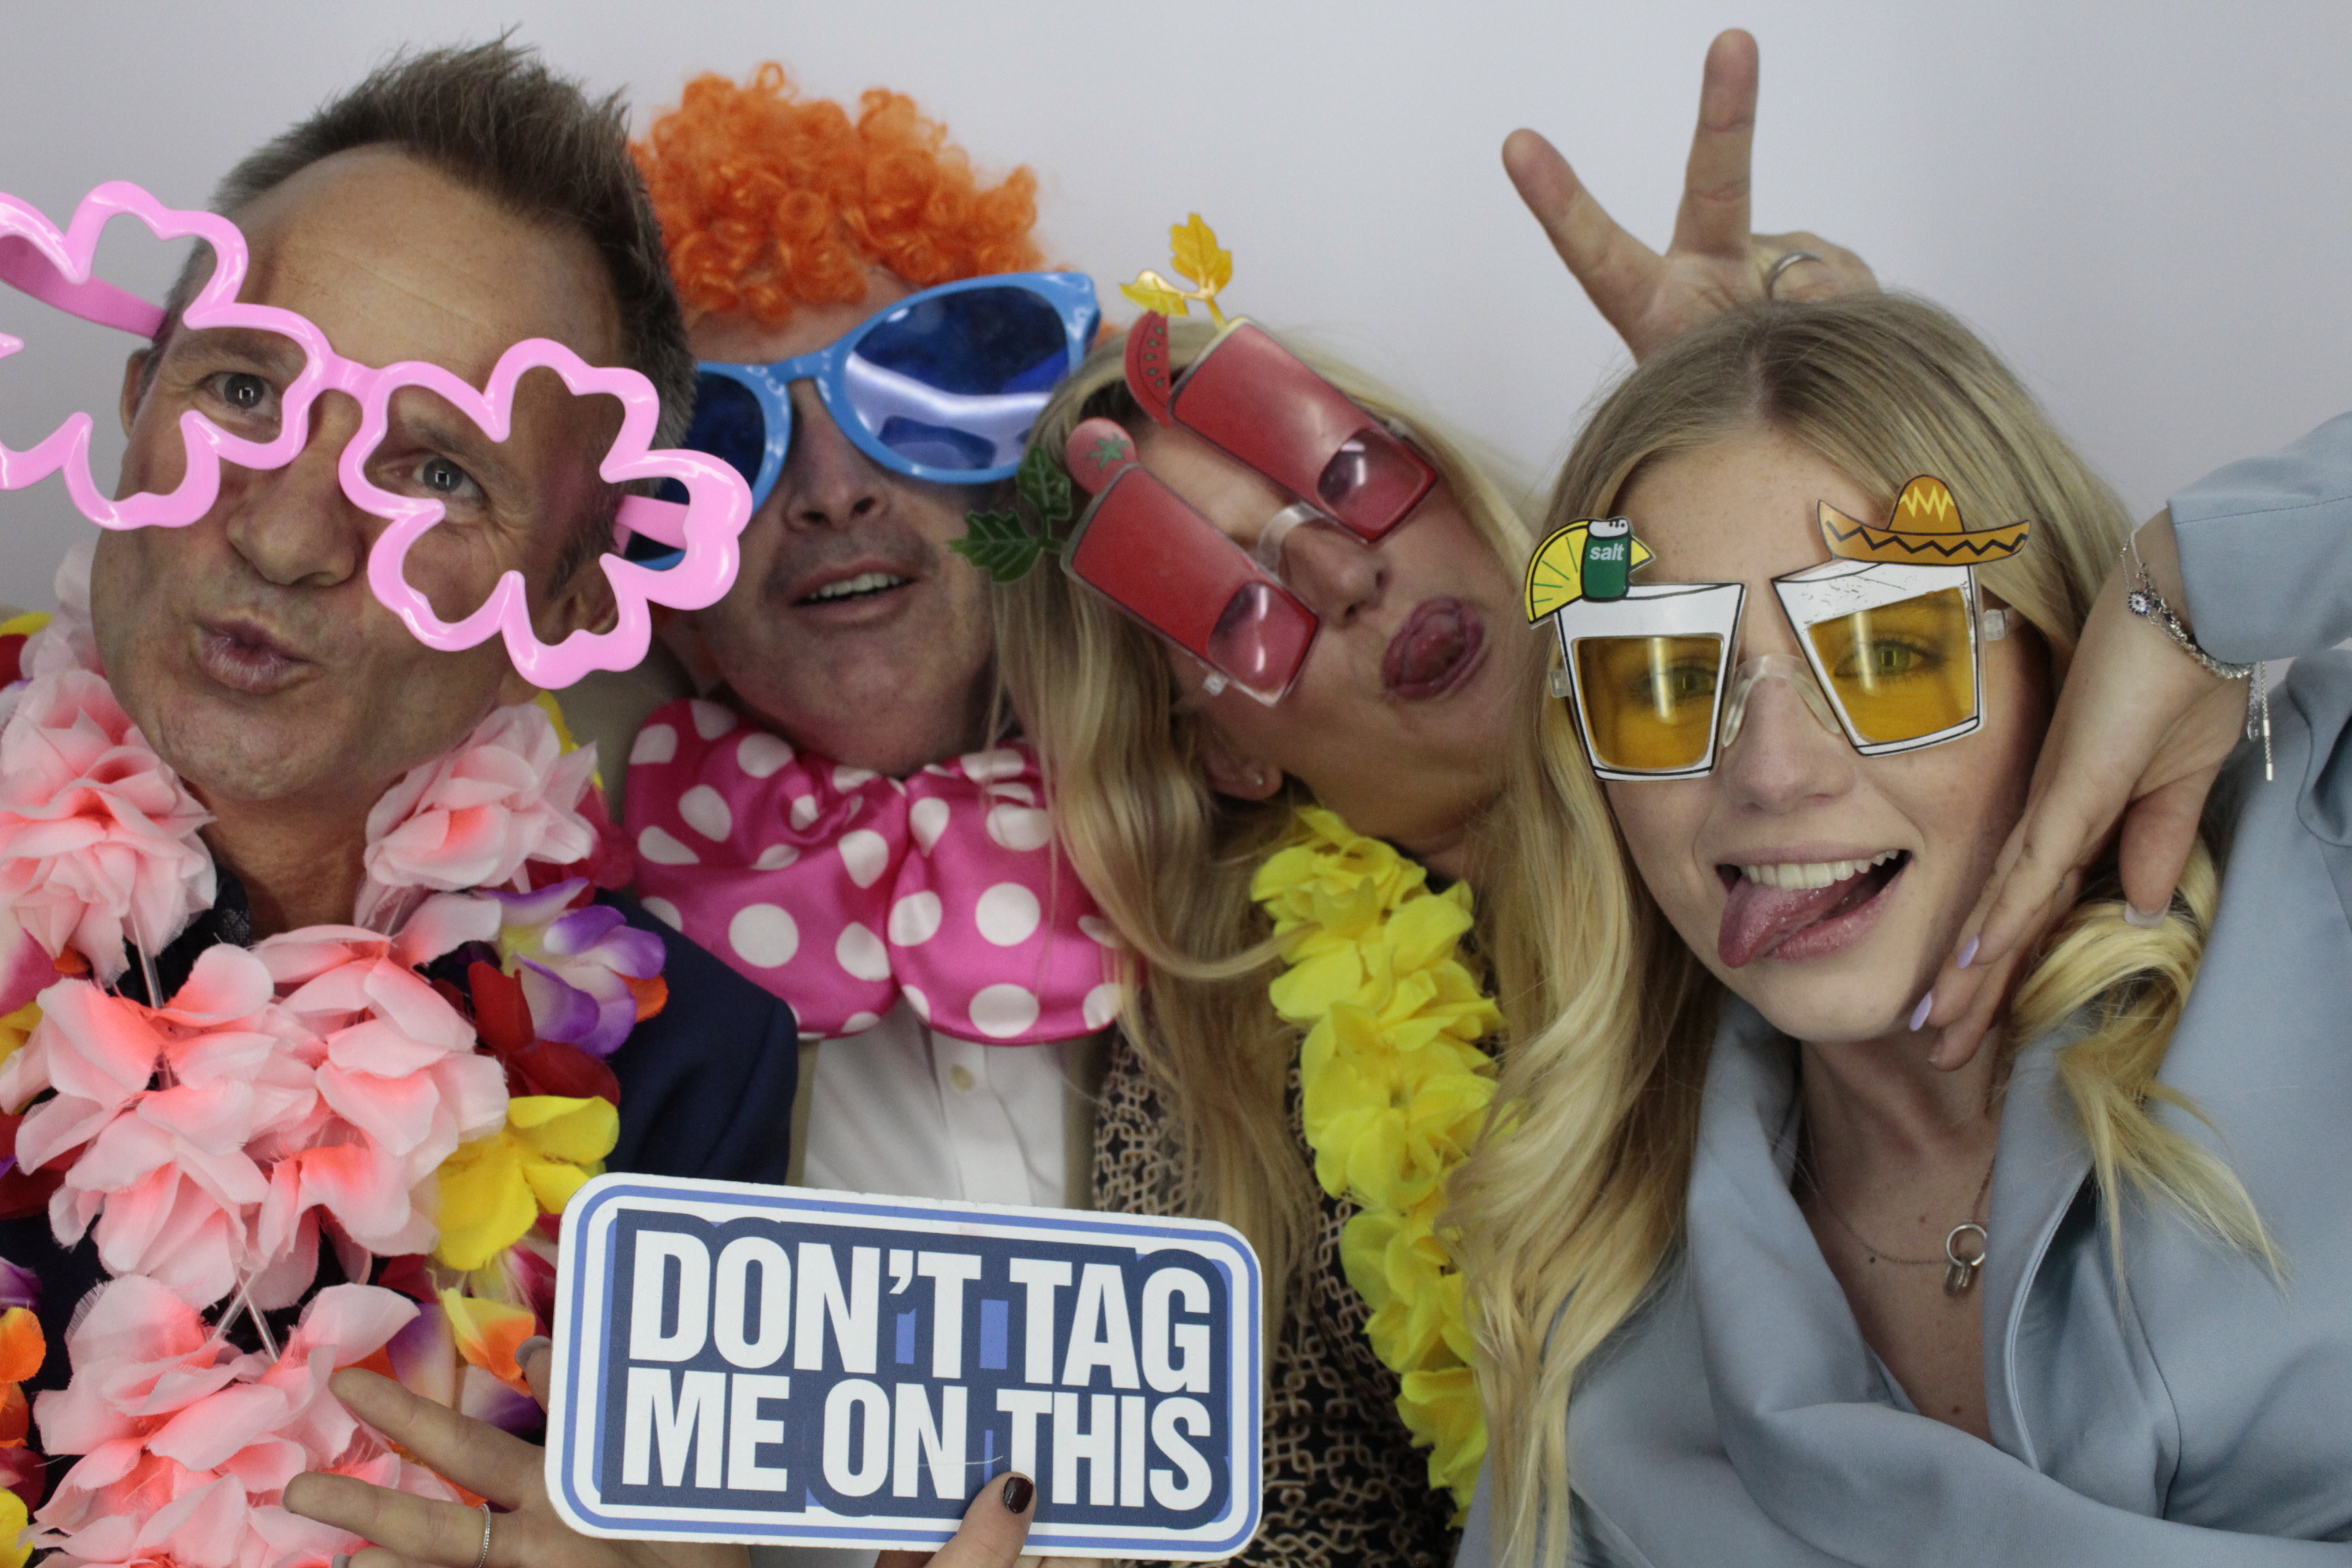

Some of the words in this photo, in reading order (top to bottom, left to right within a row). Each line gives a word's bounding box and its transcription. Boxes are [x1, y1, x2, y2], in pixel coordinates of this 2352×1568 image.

[1590, 543, 1625, 561] salt
[630, 1230, 981, 1379] DON'T
[1009, 1256, 1210, 1393] TAG
[622, 1367, 789, 1492] ME
[823, 1379, 968, 1500] ON
[996, 1388, 1212, 1512] THIS
